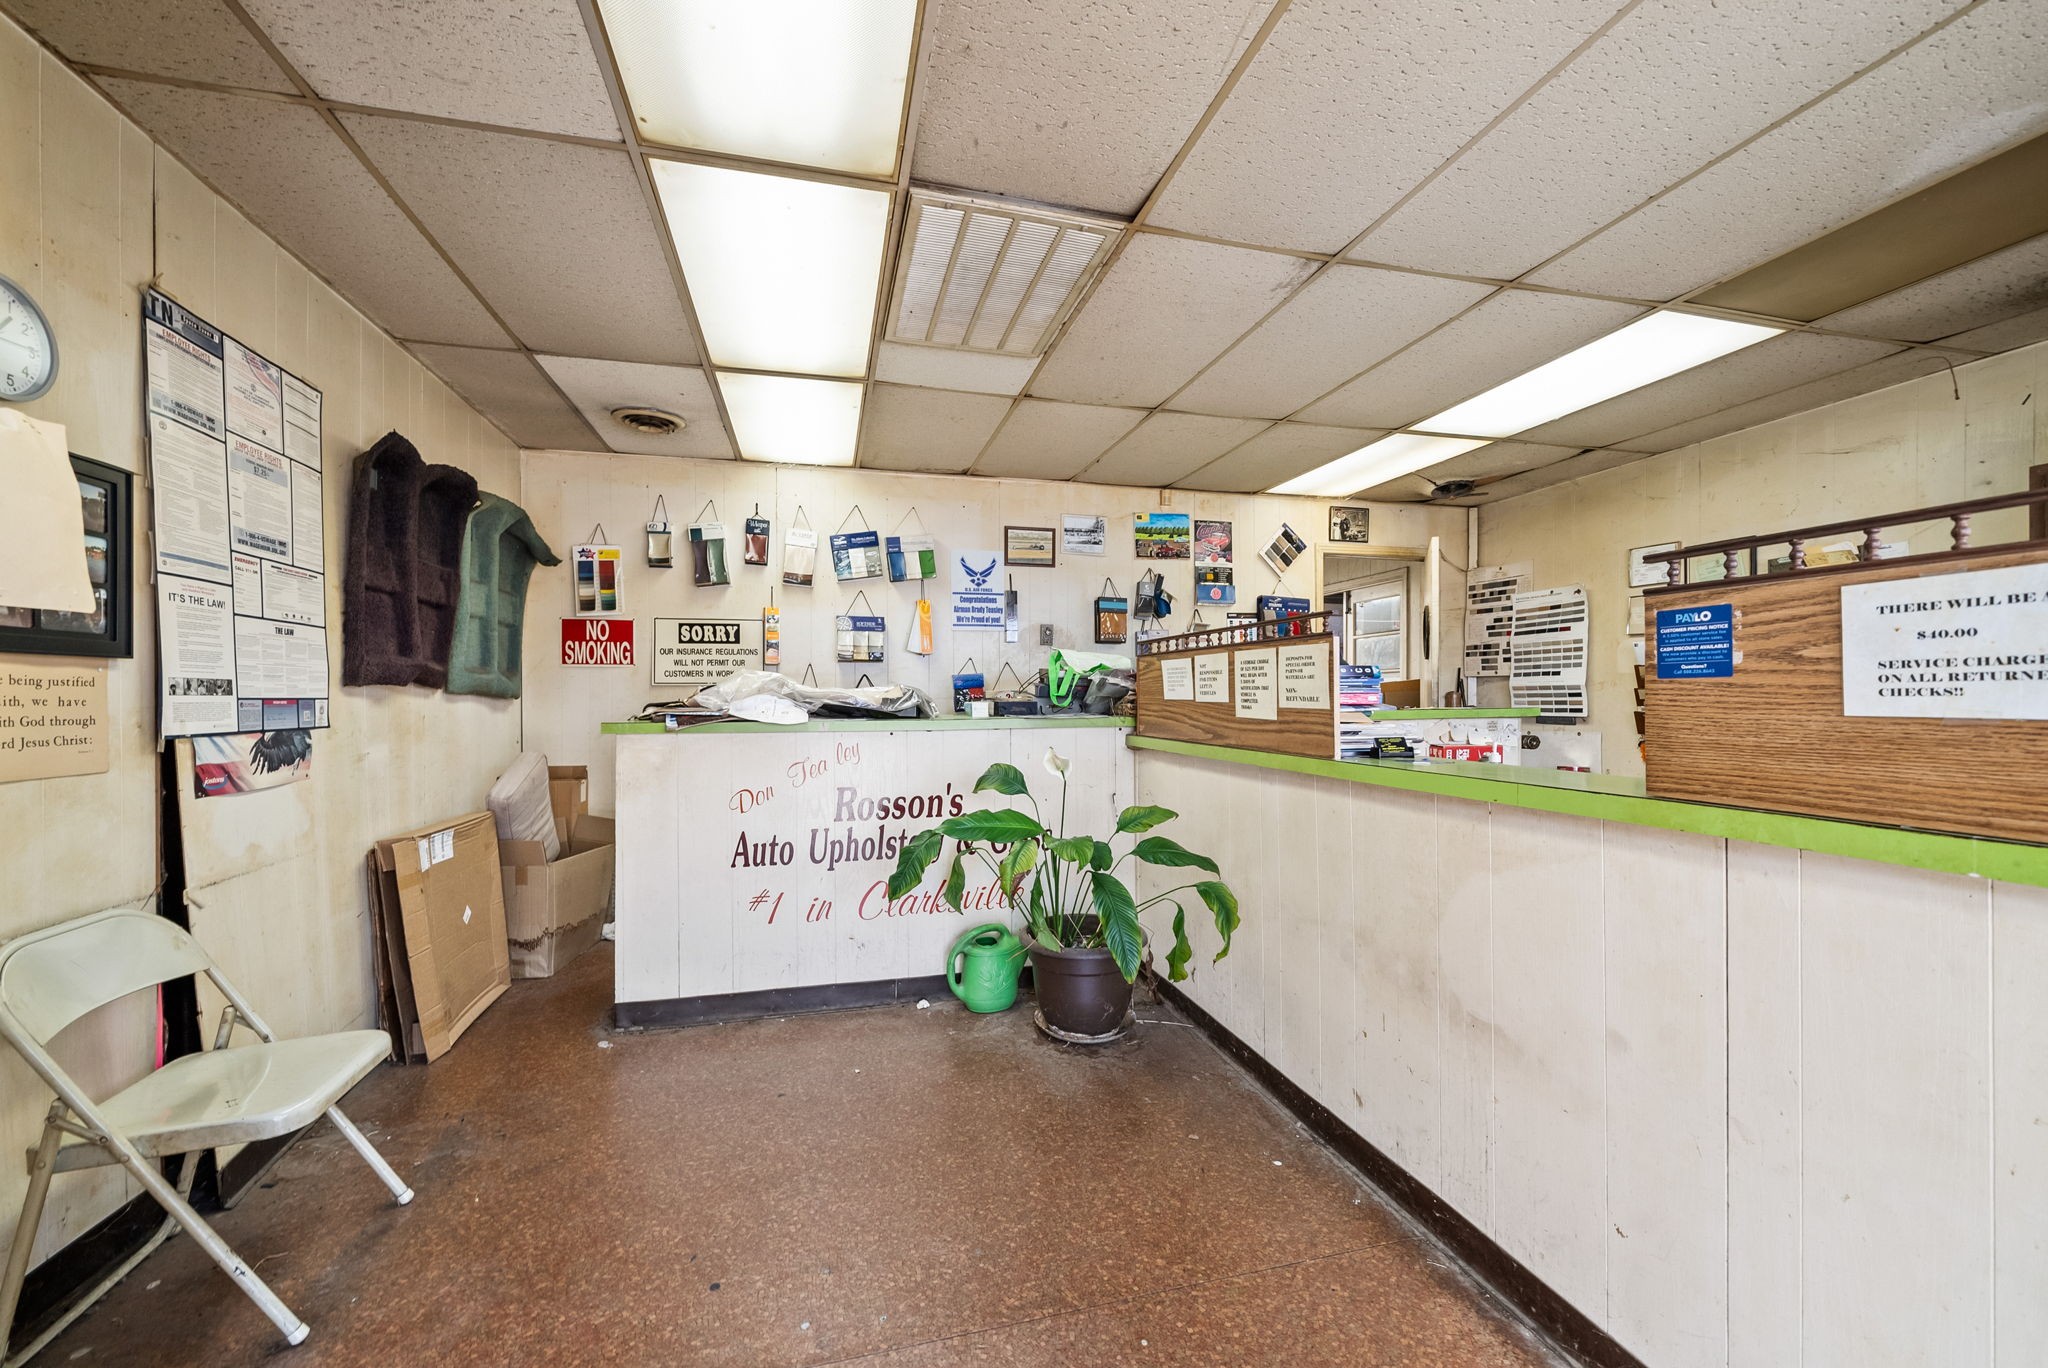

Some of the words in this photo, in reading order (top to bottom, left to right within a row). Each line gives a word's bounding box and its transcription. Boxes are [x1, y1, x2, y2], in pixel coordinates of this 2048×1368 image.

[149, 292, 173, 327] TN
[21, 322, 30, 336] 2
[21, 365, 29, 379] 4
[6, 373, 15, 388] 5
[168, 592, 186, 603] IT'S
[188, 595, 205, 606] THE
[207, 598, 226, 609] LAW!
[959, 595, 998, 604] Congratulations
[1876, 600, 1942, 615] THERE
[1947, 595, 2002, 610] WILL
[2007, 591, 2036, 604] BE
[971, 615, 985, 623] Proud
[1675, 610, 1712, 624] PAYLO
[275, 626, 284, 635] THE
[284, 628, 295, 636] LAW
[585, 619, 610, 641] NO
[680, 625, 739, 642] SORRY
[1660, 626, 1687, 634] CUSTOMER
[1916, 627, 1978, 641] $40.00
[564, 640, 631, 665] SMOKING
[659, 648, 674, 656] OUR
[676, 648, 713, 656] INSURANCE
[715, 648, 759, 656] REGULATIONS
[1877, 657, 1958, 670] SERVICE
[1962, 654, 2048, 667] CHARGE
[663, 670, 704, 678] CUSTOMERS
[1877, 673, 1902, 684] ON
[1907, 673, 1944, 683] ALL
[1947, 669, 2048, 682] RETURNE
[8, 674, 42, 690] being
[46, 675, 95, 690] justified
[1878, 687, 1965, 697] CHECKS!!
[0, 695, 25, 709] ith,
[31, 698, 48, 707] we
[57, 695, 87, 707] have
[19, 715, 45, 728] God
[49, 714, 96, 729] through
[18, 736, 50, 752] Jesus
[53, 734, 93, 747] Christ:
[203, 775, 225, 786] jostens
[728, 785, 775, 814] Don
[833, 782, 964, 823] Rosson's
[730, 831, 795, 868] Auto
[809, 824, 944, 872] Upholst
[748, 888, 785, 925] #1
[806, 897, 833, 923] in
